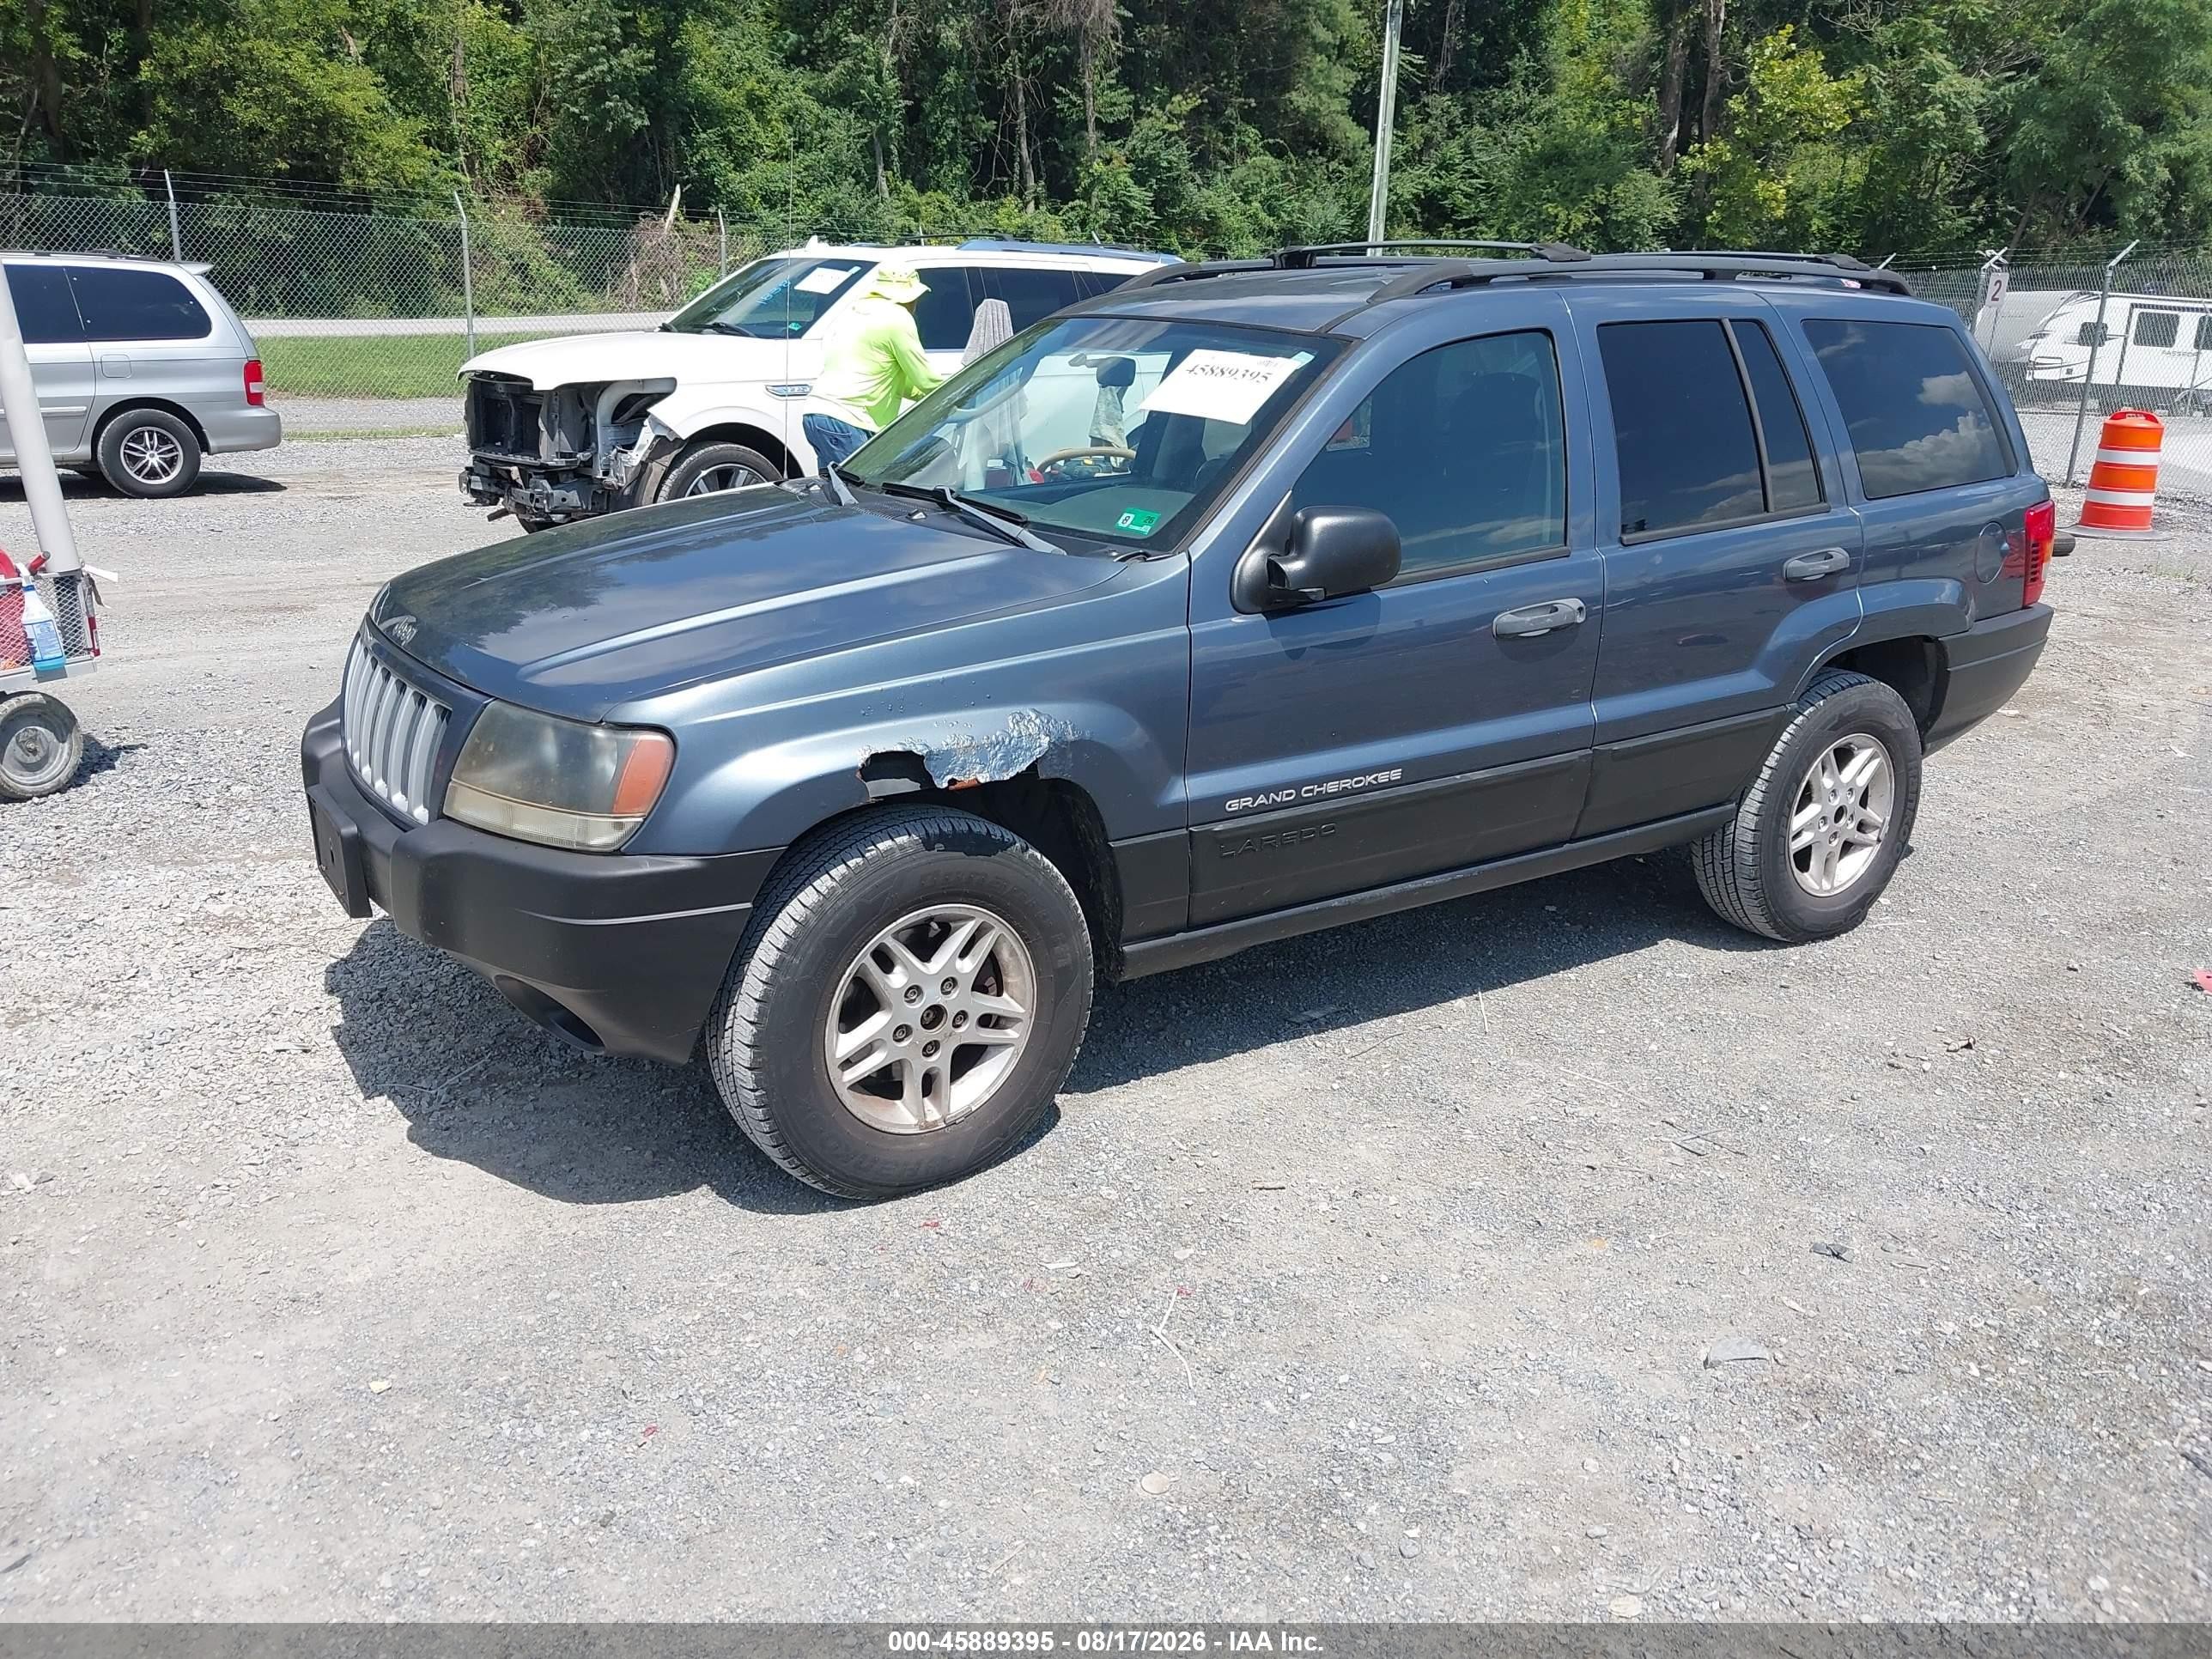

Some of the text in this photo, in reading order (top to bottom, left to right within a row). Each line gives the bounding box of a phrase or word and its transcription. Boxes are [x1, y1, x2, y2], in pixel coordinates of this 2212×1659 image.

[1990, 280, 2002, 301] 2
[1186, 364, 1273, 384] 45889395
[1121, 515, 1156, 525] 8 26
[1225, 769, 1402, 811] GRAND CHEROKEE
[1220, 823, 1336, 858] LAREDO
